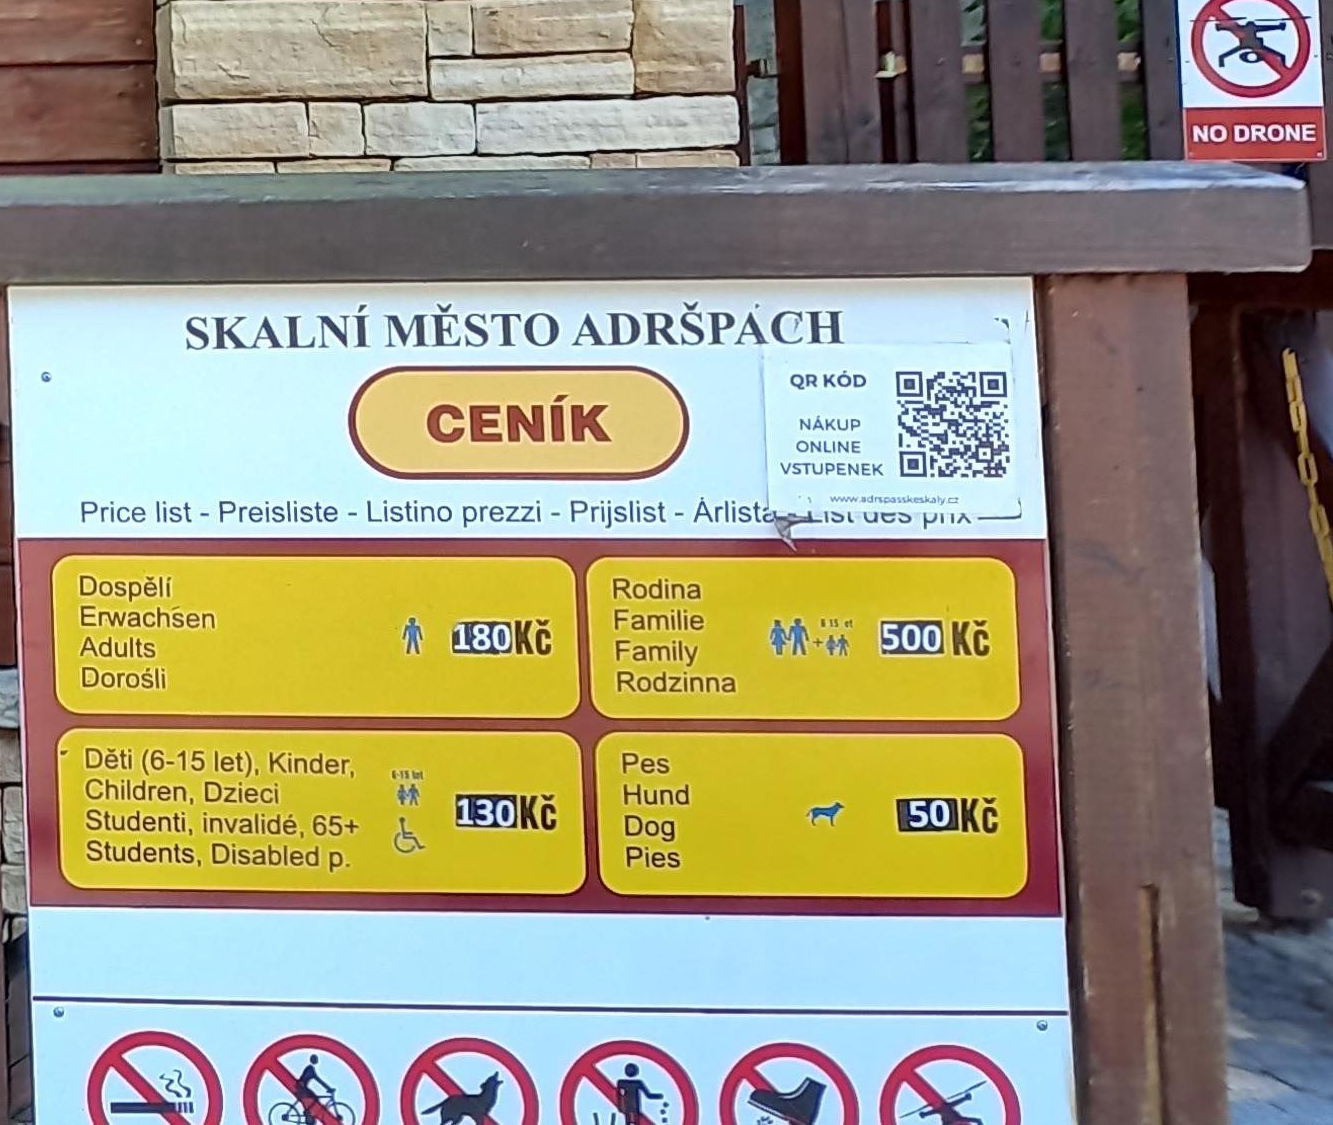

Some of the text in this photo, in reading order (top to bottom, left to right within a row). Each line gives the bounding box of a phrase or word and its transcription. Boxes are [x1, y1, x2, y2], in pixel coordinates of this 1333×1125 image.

[1192, 124, 1317, 143] NO DRONE
[185, 304, 370, 350] SKALNÍ
[384, 303, 560, 347] MĚSTO
[790, 370, 867, 390] QR KÓD
[426, 393, 612, 444] CENÍK
[799, 415, 861, 431] NÁKUP
[796, 440, 862, 454] ONLINE
[780, 462, 884, 476] VSTUPENEK
[830, 494, 959, 505] www.adrspasskeskaly.cz
[81, 501, 146, 523] Price
[156, 501, 192, 523] list
[219, 501, 338, 523] Preisliste
[367, 500, 452, 523] Listino
[462, 500, 542, 528] prezzi
[570, 500, 666, 528] Prijslist
[79, 575, 171, 602] Dospělí
[613, 578, 701, 600] Rodina
[614, 609, 704, 630] Familie
[80, 636, 156, 658] Adults
[881, 619, 990, 656] 500 Kč
[615, 640, 698, 667] Family
[82, 667, 166, 689] Dorośli
[617, 671, 736, 693] Rodzinna
[85, 748, 355, 778] Děti (6-15 let), Kinder,
[622, 752, 670, 774] Pes
[85, 779, 280, 805] Children, Dzieci
[623, 784, 690, 805] Hund
[86, 809, 360, 838] Studenti, invalidé, 65+
[624, 815, 675, 842] Dog
[86, 840, 351, 873] Students, Disabled p.
[626, 846, 681, 868] Pies
